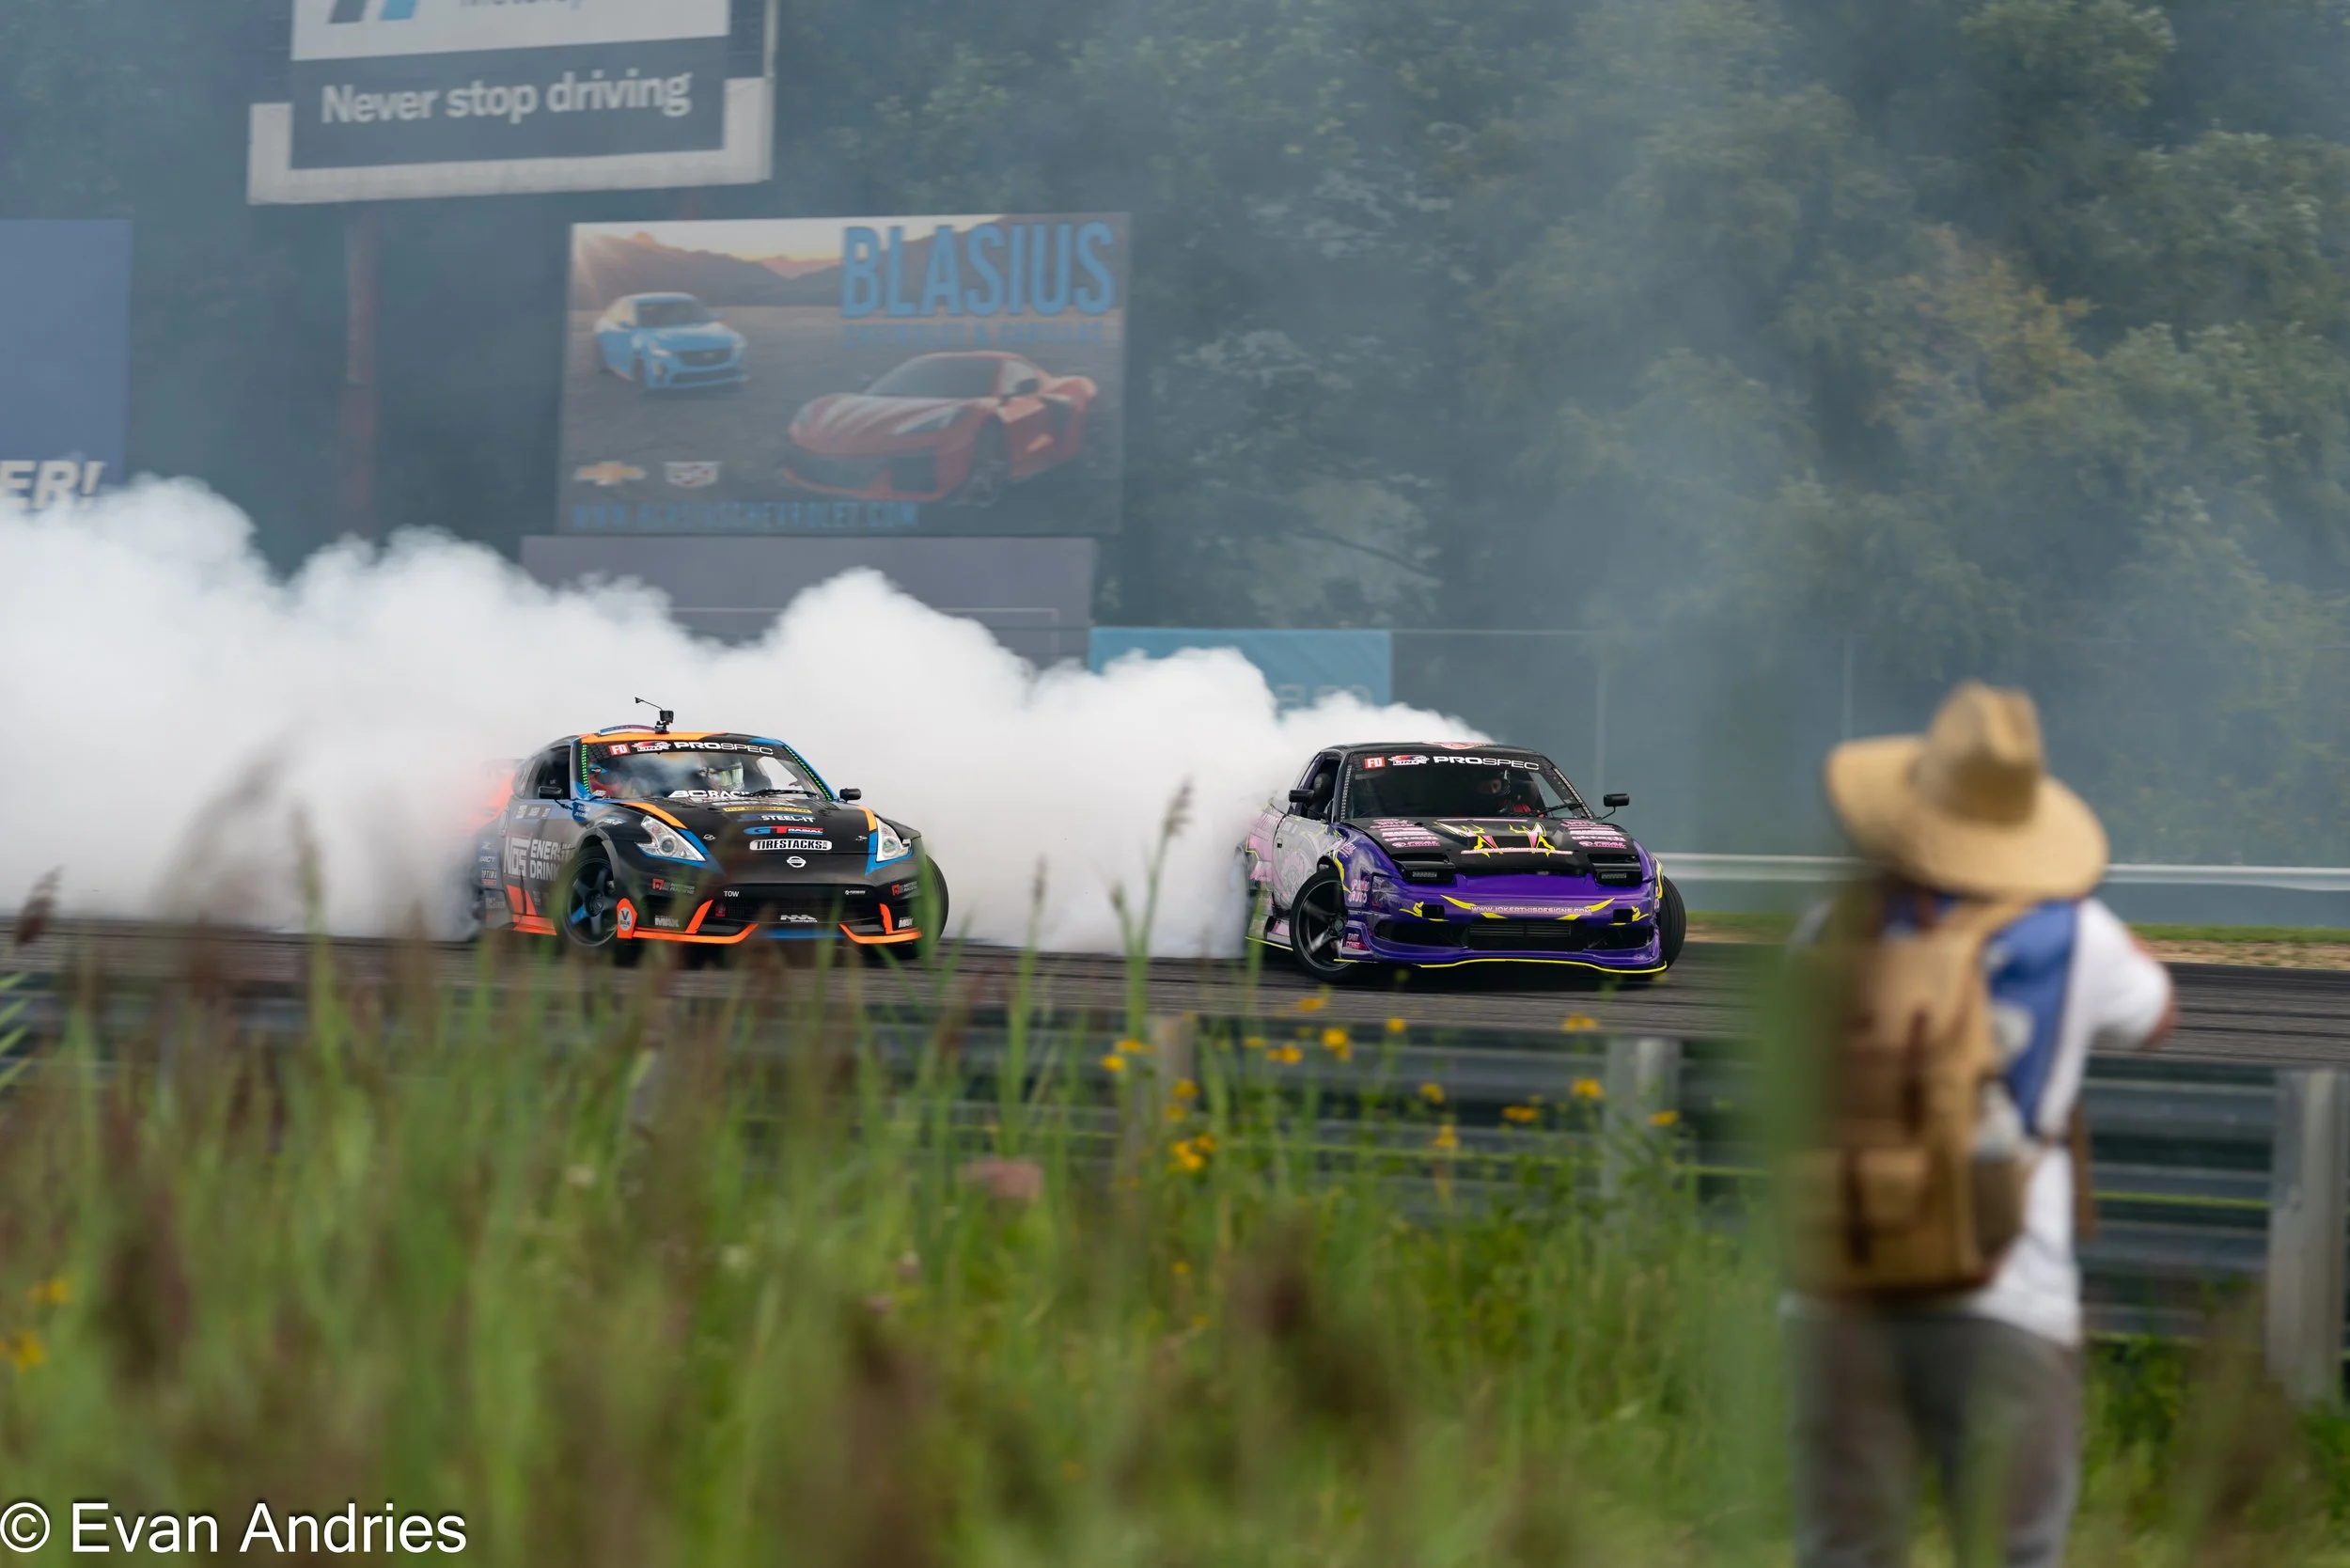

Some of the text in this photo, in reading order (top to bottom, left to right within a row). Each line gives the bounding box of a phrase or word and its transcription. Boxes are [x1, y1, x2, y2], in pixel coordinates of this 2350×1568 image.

[321, 68, 693, 123] Never stop driving
[841, 222, 1116, 317] BLASIUS
[611, 745, 626, 754] FD
[674, 742, 774, 755] PROSPEC
[1367, 758, 1383, 768] FD
[1433, 756, 1540, 771] PROSPEC
[744, 825, 788, 835] GT
[755, 839, 822, 850] TIRESTACKS
[504, 836, 530, 877] NOS
